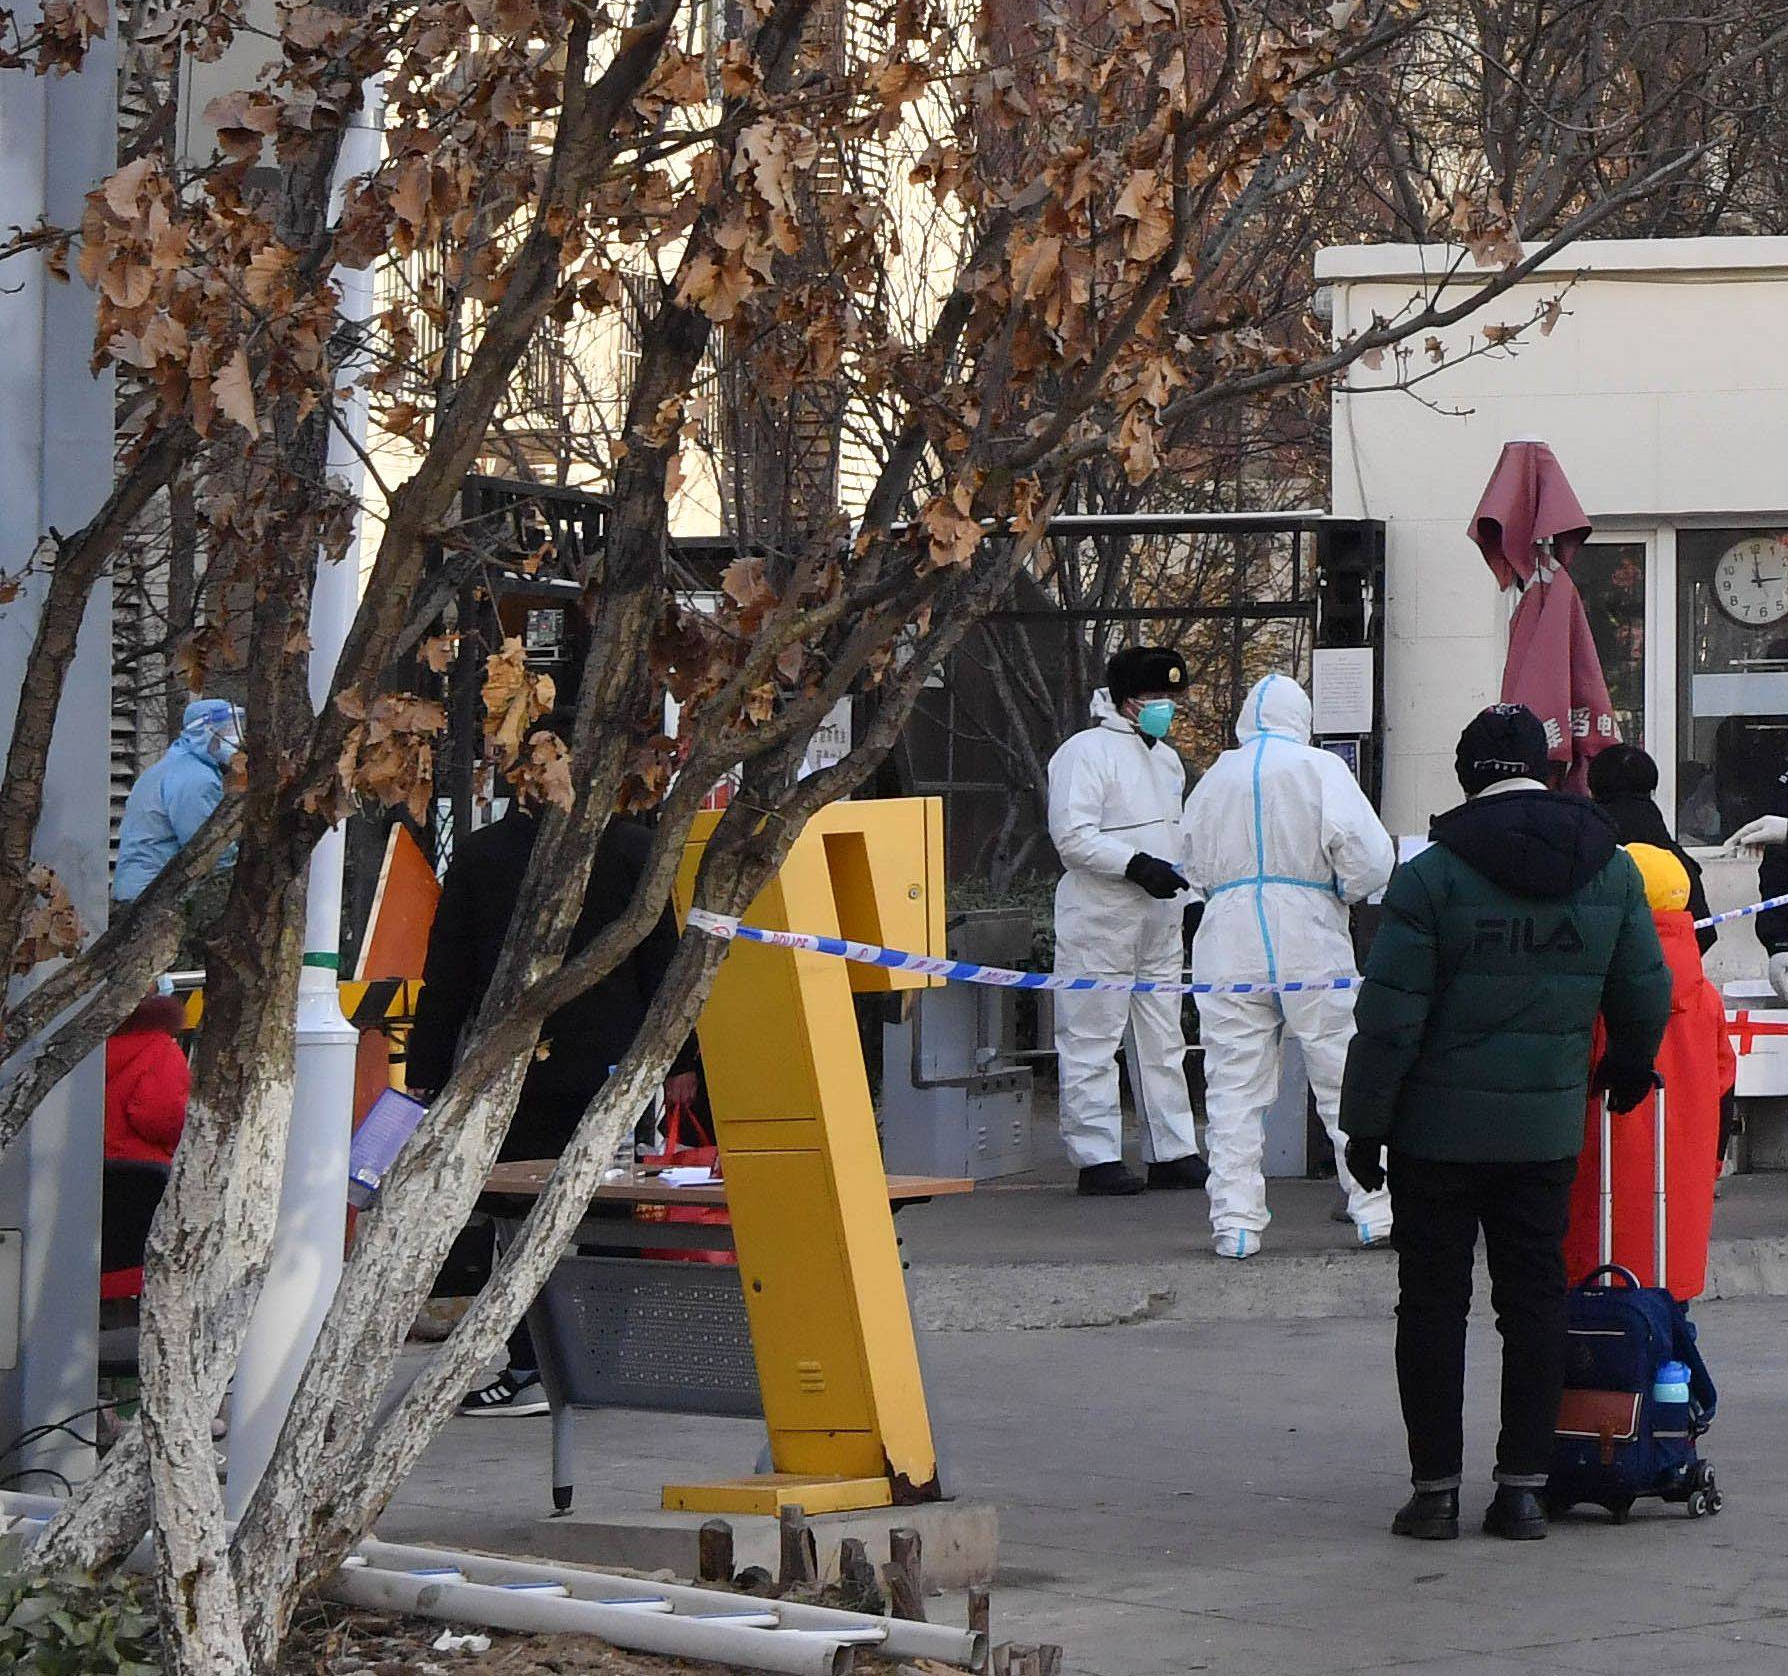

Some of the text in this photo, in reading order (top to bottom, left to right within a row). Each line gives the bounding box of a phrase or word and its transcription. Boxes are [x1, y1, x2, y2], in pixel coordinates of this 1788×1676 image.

[1723, 565, 1735, 576] 10
[1723, 580, 1731, 591] 9
[1730, 595, 1738, 606] 8
[1775, 600, 1784, 611] 5
[1742, 605, 1751, 616] 7
[1759, 606, 1768, 617] 6
[1472, 917, 1585, 954] FILA
